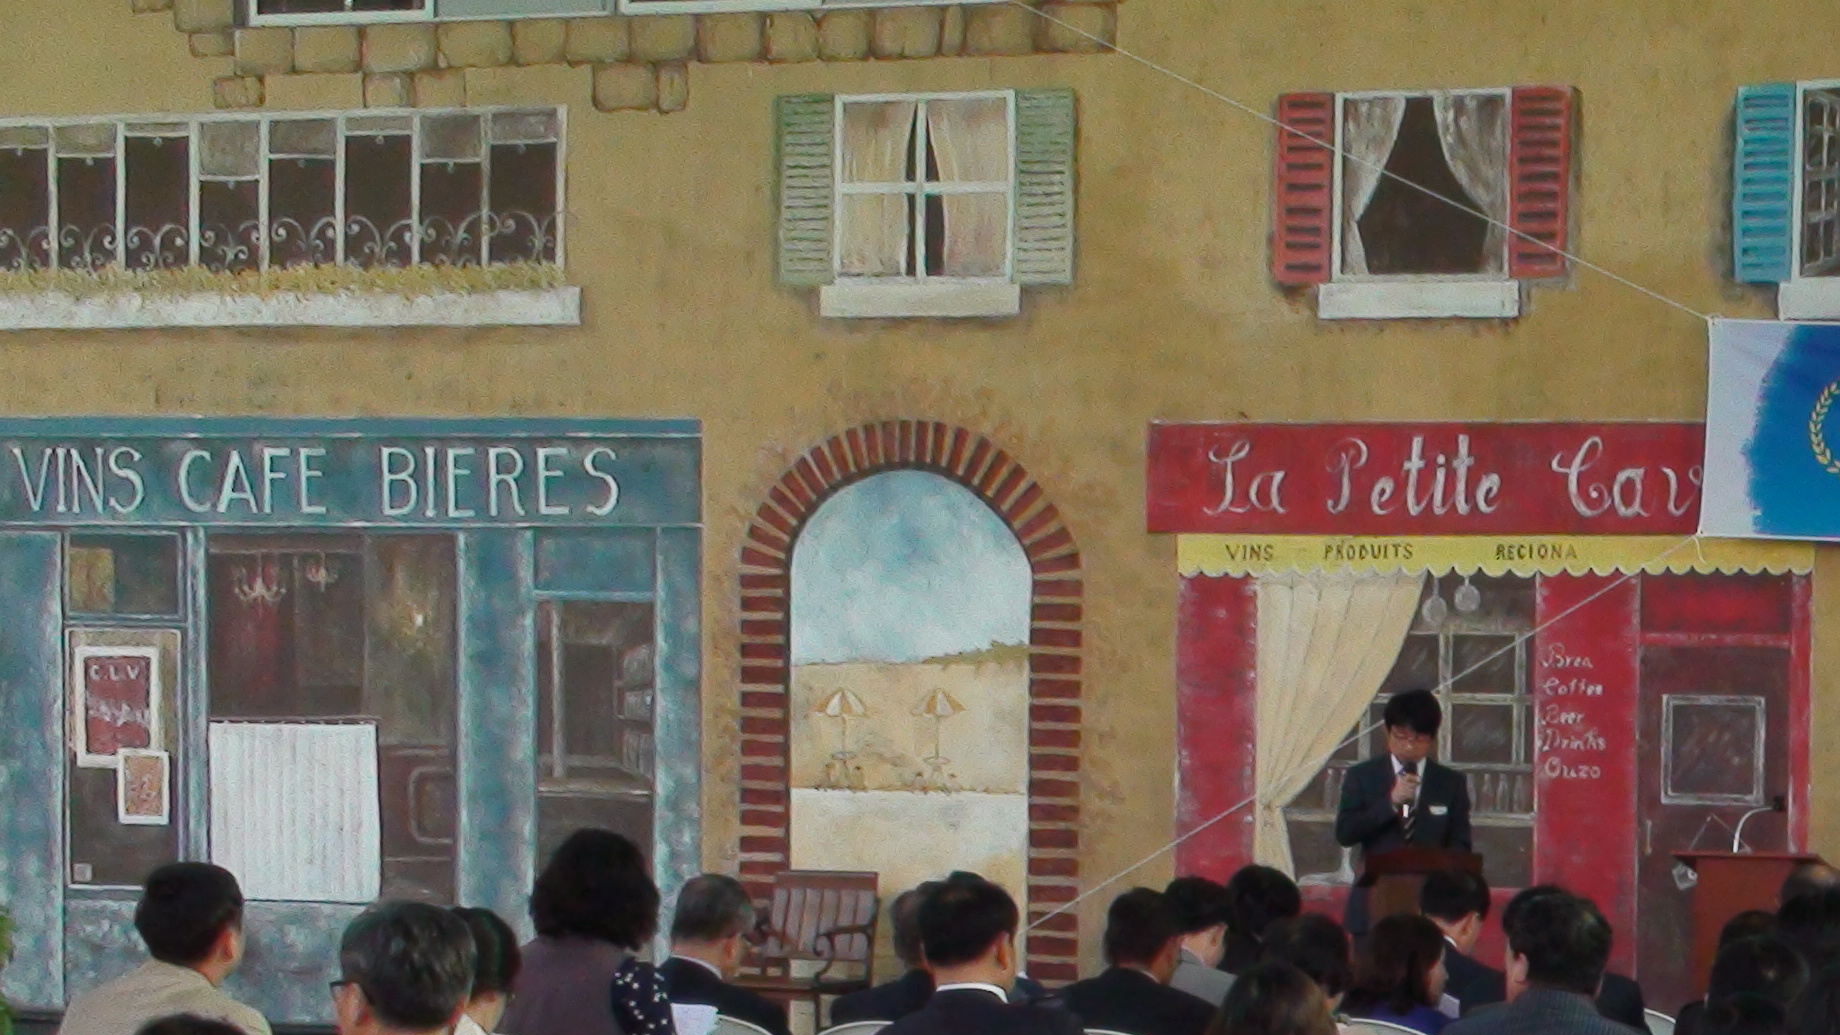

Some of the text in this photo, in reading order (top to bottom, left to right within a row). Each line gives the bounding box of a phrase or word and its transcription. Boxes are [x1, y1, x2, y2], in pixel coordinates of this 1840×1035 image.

[11, 446, 621, 519] VINS CAFE BIERES
[1203, 439, 1288, 516] La
[1325, 434, 1502, 516] Petite
[1225, 544, 1274, 562] VINS
[1322, 543, 1415, 562] PRODUITS
